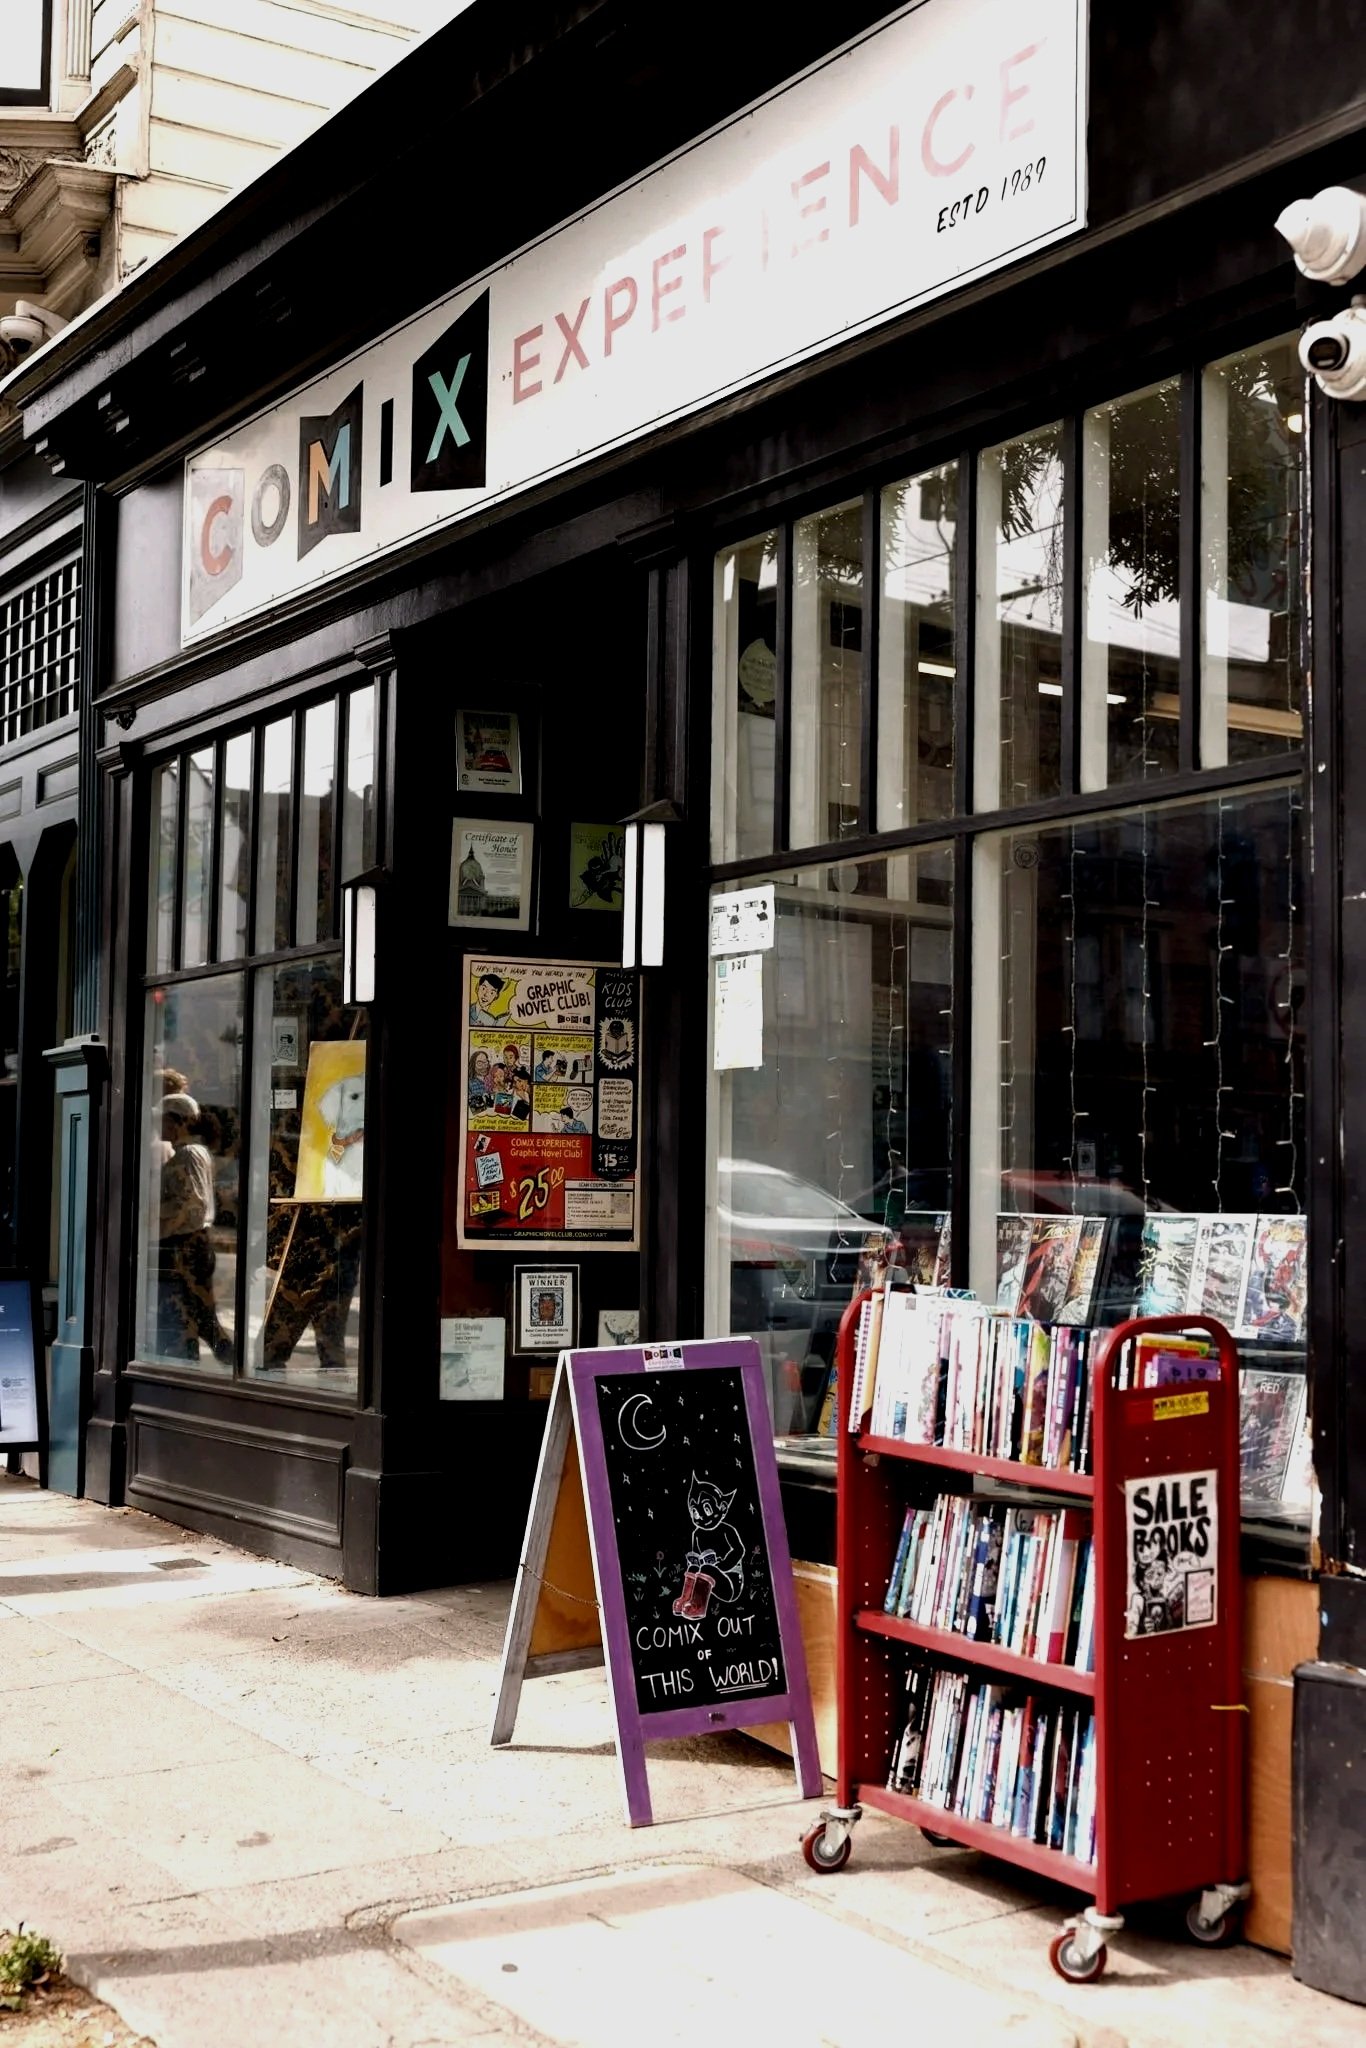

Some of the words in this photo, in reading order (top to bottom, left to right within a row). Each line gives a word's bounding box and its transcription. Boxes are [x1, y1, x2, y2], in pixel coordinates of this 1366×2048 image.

[936, 186, 990, 235] ESTD
[1000, 156, 1047, 204] 1989
[200, 354, 473, 576] COMIX
[465, 832, 507, 845] Certificate
[509, 833, 519, 846] of
[491, 843, 518, 853] Honor
[527, 979, 576, 1001] GRAPHIC
[602, 982, 634, 996] KIDS
[516, 998, 555, 1018] NOVEL
[557, 991, 591, 1011] CLUB!
[605, 996, 633, 1008] CLUB
[511, 1138, 534, 1147] COMIX
[536, 1138, 581, 1149] EXPERIENCE
[510, 1149, 540, 1158] Graphic
[541, 1149, 562, 1158] Novel
[563, 1149, 583, 1158] Club!
[528, 1279, 566, 1287] WINNER
[1260, 1381, 1280, 1394] RED
[1132, 1477, 1209, 1526] SALE
[1132, 1516, 1212, 1562] BOOKS
[636, 1622, 704, 1651] COMIX
[717, 1614, 756, 1638] OUT
[697, 1649, 713, 1661] OF
[640, 1668, 695, 1698] THIS
[708, 1657, 779, 1688] WORLD!
